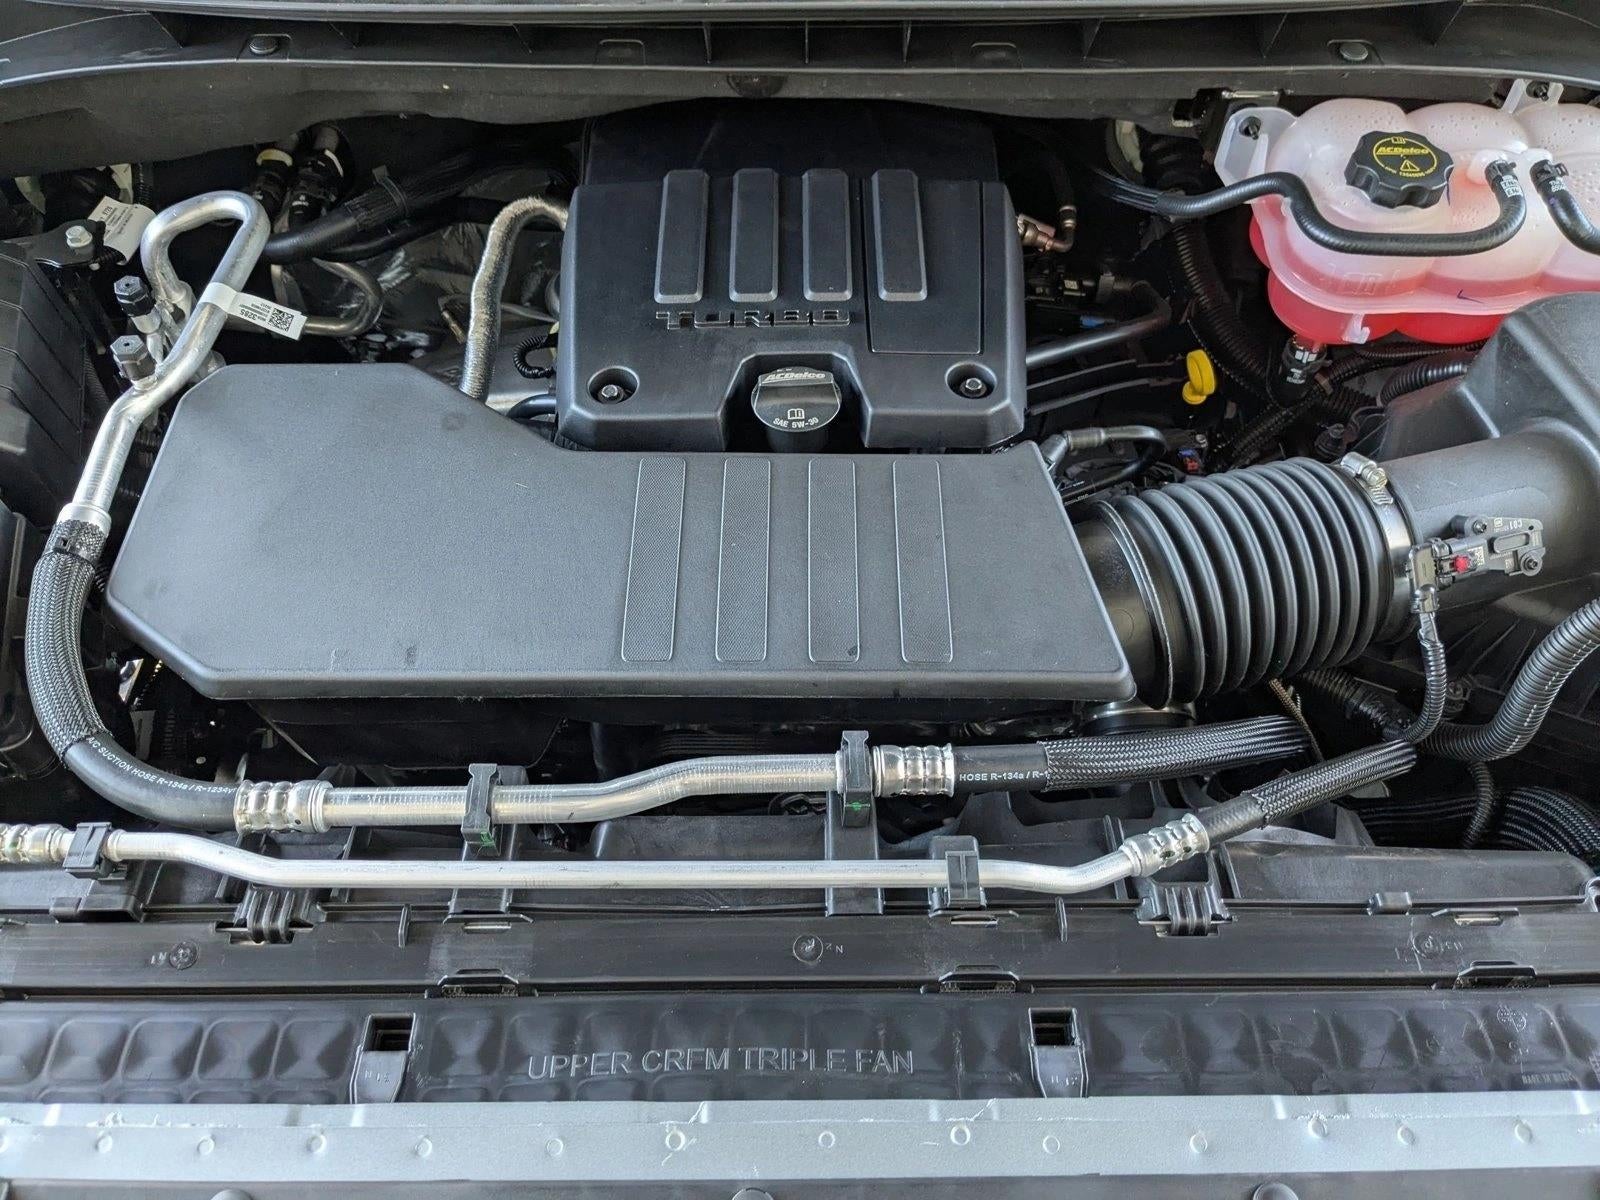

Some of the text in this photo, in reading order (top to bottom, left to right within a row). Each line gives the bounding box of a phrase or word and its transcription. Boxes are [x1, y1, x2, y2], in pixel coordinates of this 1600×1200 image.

[1376, 146, 1430, 156] ACDelco
[656, 310, 850, 330] TURBO
[763, 372, 826, 383] ACDelco
[773, 417, 819, 429] SAE 5W-30
[98, 746, 132, 772] SUCTION
[131, 767, 157, 783] HOSE
[157, 777, 188, 790] R-134a
[959, 773, 988, 782] HOSE
[990, 771, 1024, 781] R-134a
[527, 1046, 914, 1080] UPPER CRFM TRIPLE FAN
